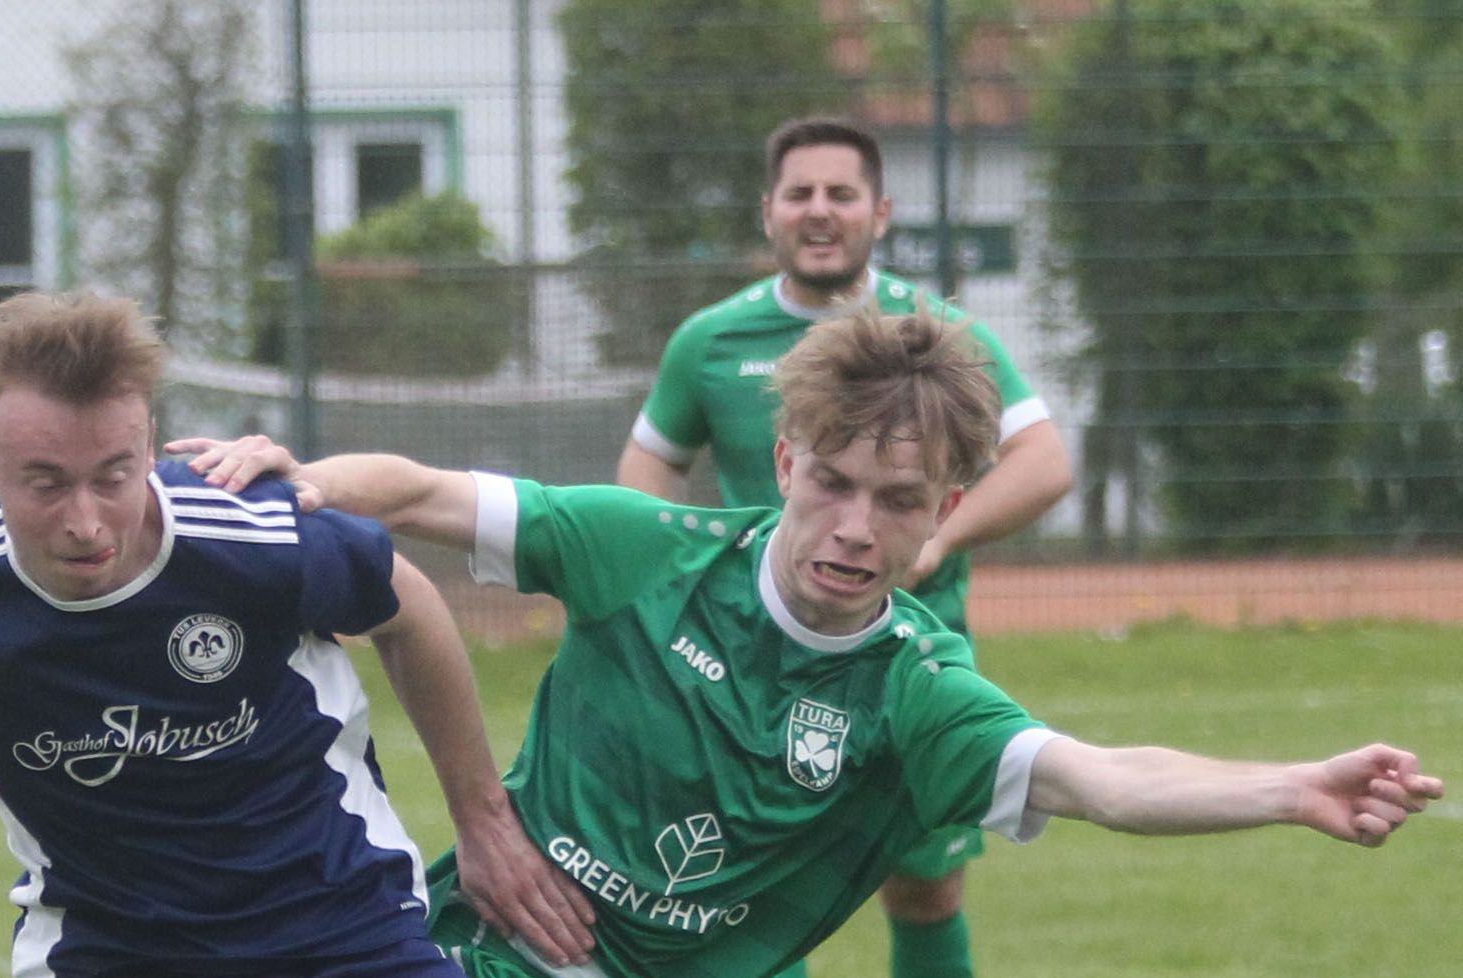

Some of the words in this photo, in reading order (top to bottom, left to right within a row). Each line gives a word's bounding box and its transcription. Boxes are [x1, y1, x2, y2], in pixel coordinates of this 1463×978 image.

[670, 636, 725, 682] JAKO
[13, 732, 114, 770] Gasthof
[64, 698, 259, 787] Jobusch
[798, 702, 845, 729] TURA
[548, 836, 649, 913] GREEN
